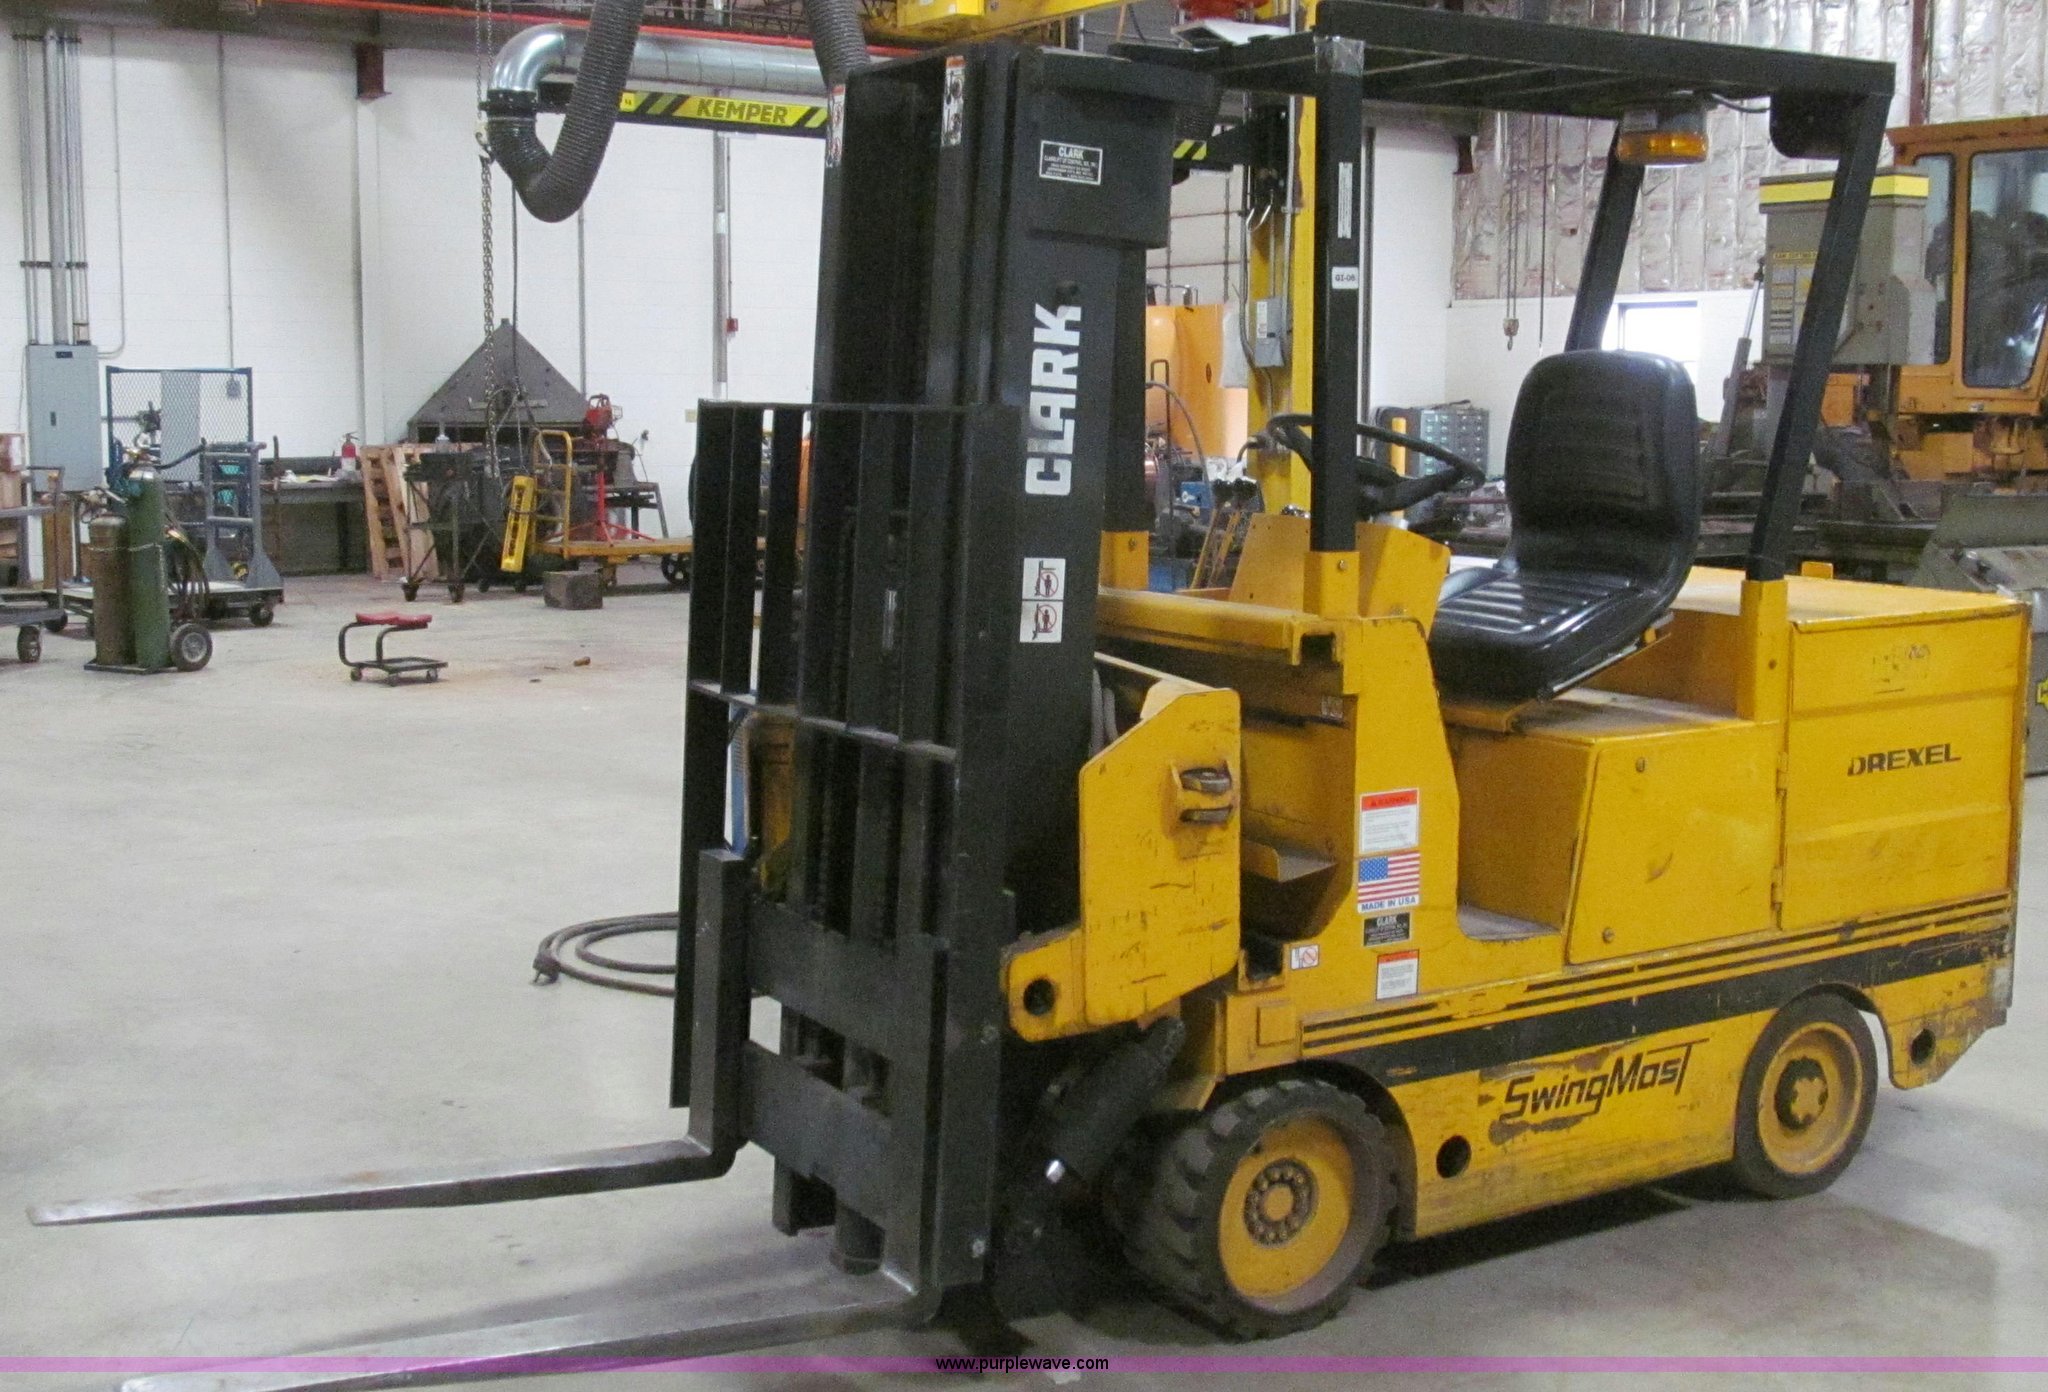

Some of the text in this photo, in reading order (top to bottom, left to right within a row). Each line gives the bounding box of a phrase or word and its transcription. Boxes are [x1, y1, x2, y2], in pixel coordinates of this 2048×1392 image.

[697, 98, 788, 125] KEMPER
[1058, 146, 1084, 160] CLARK
[1025, 302, 1082, 496] CLARK
[1847, 743, 1962, 777] DREXEL
[1361, 896, 1416, 912] MADE IN USA
[1499, 1037, 1710, 1121] SwingMast
